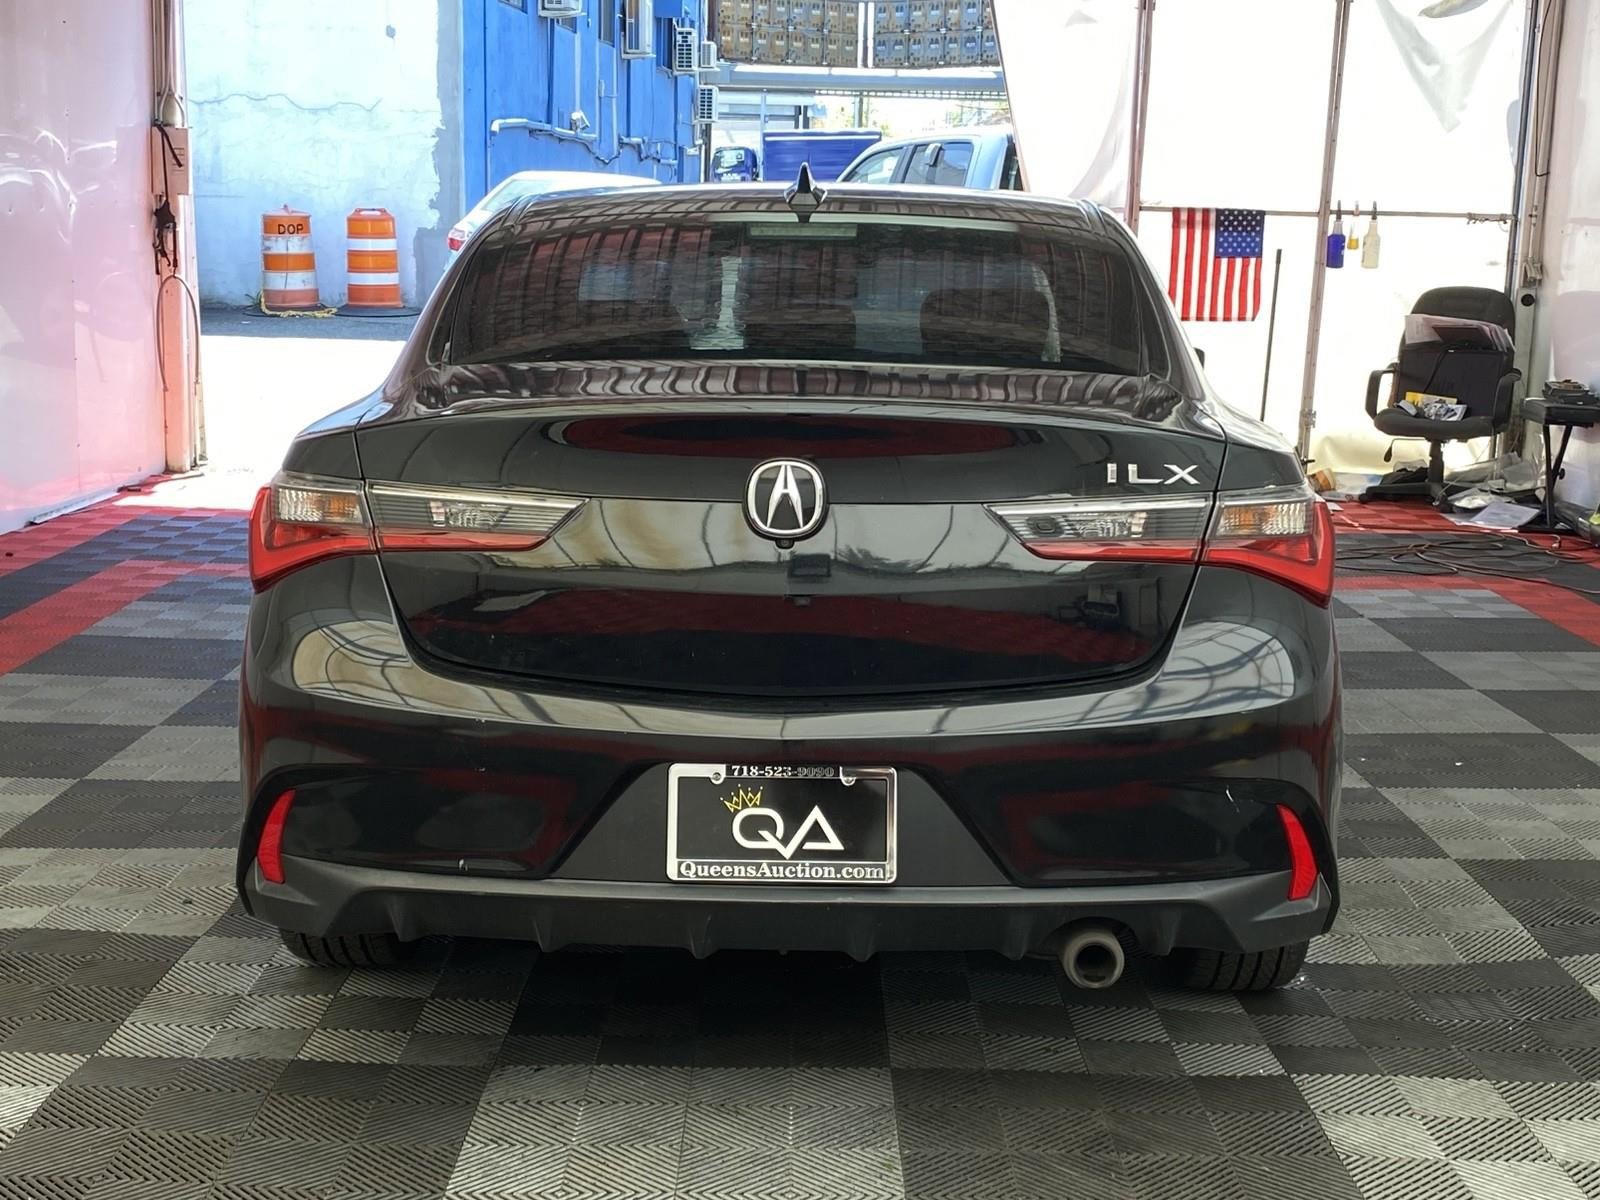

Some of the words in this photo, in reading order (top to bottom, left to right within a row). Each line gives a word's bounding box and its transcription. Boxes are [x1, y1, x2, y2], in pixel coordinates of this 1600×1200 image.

[1107, 463, 1200, 485] ILX
[732, 805, 845, 860] QA
[680, 861, 885, 880] QueensAuction.com
